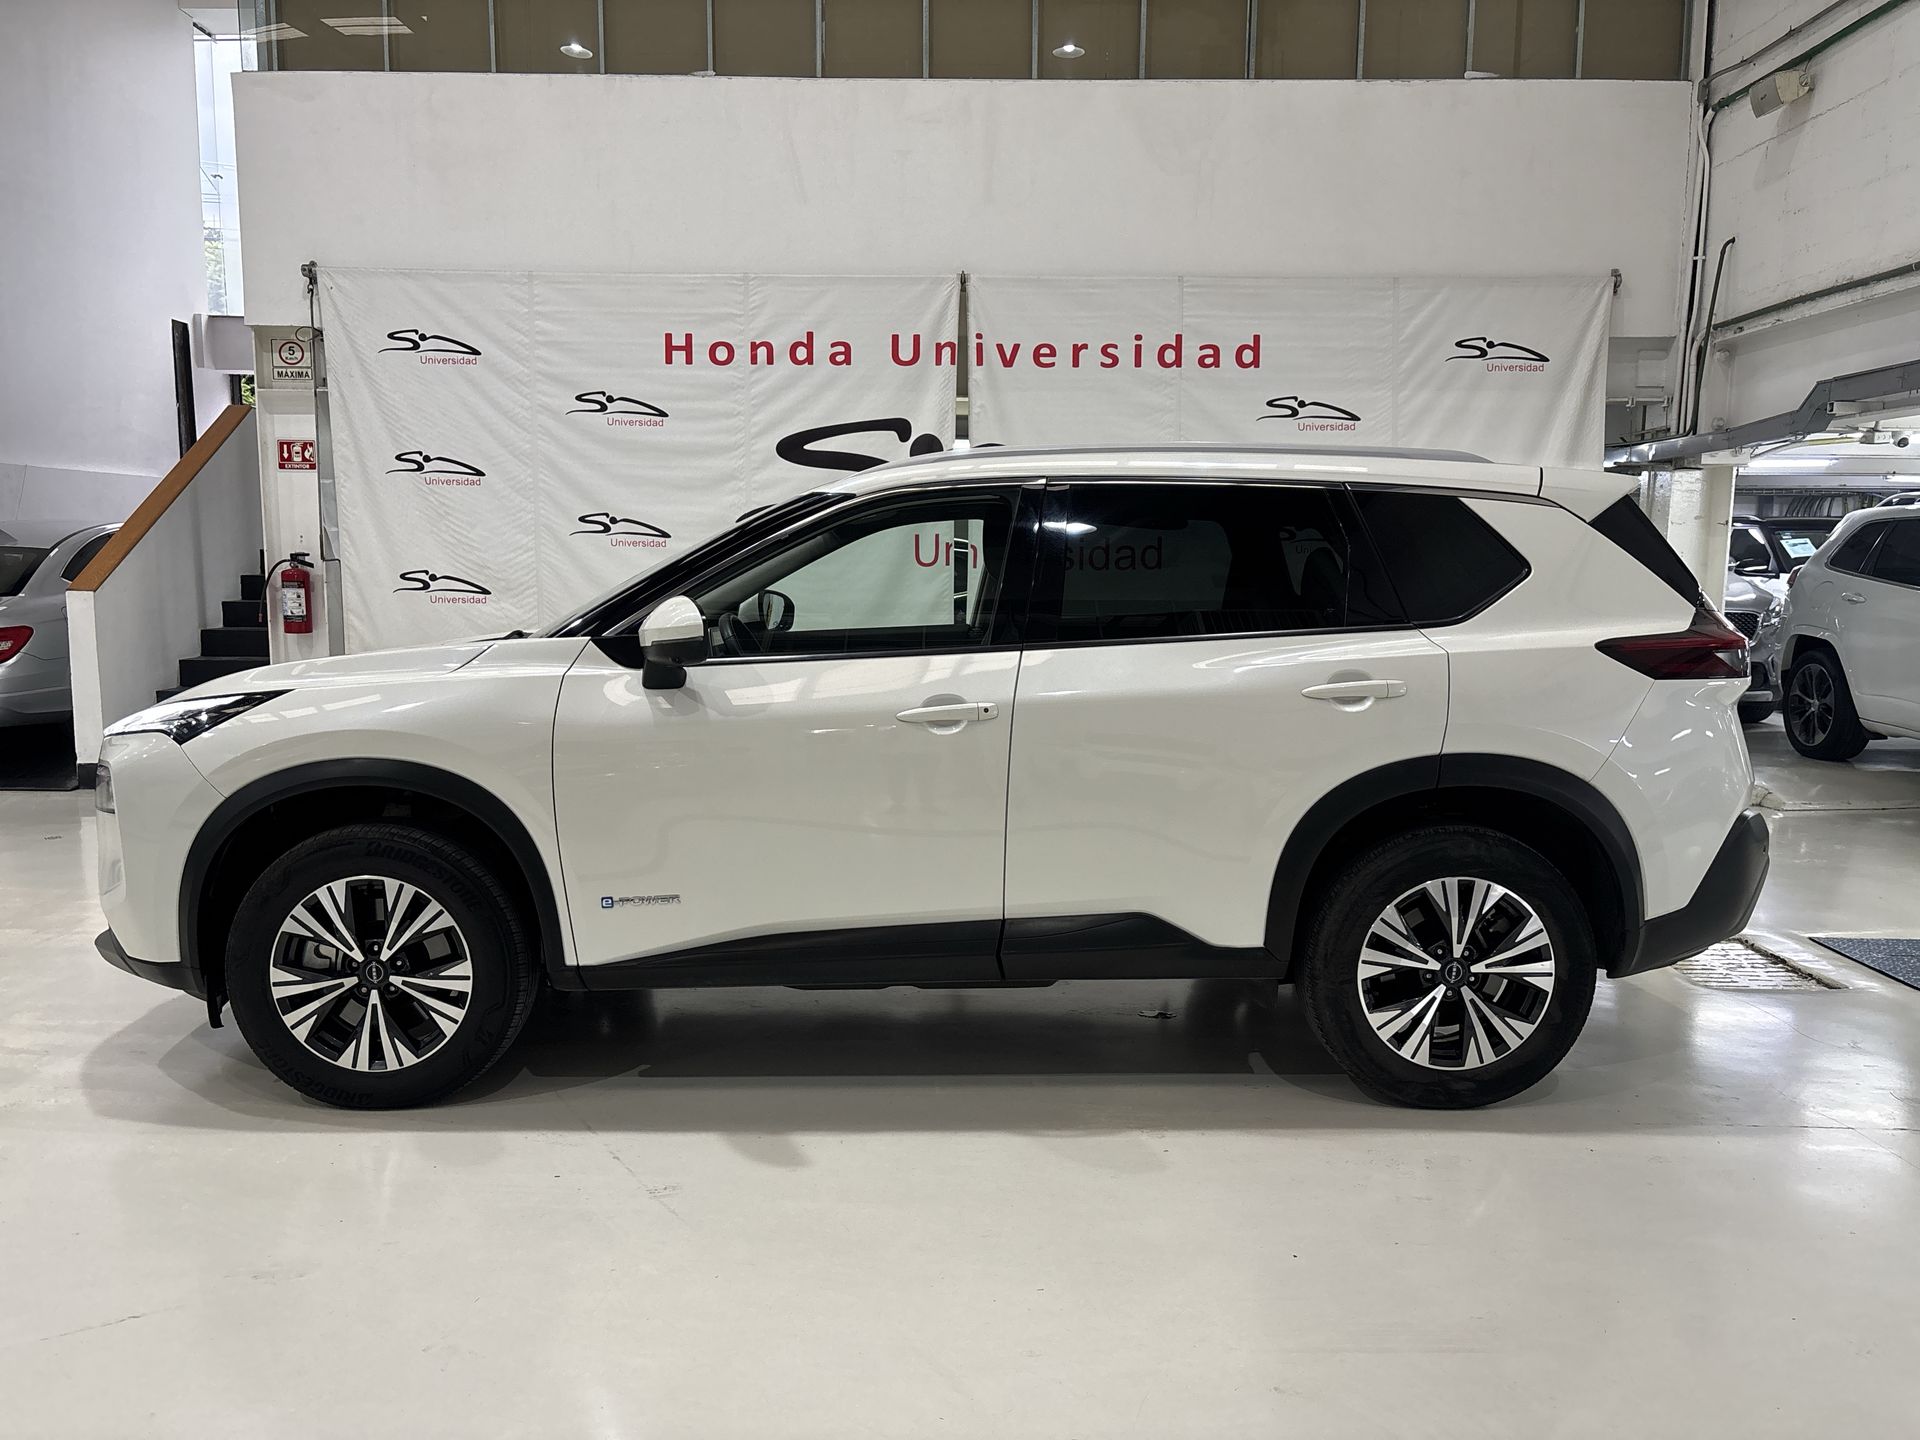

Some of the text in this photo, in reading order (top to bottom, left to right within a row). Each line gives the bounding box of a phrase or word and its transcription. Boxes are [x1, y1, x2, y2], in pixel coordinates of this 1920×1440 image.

[288, 346, 295, 356] 5
[663, 331, 1261, 369] Honda Universidad
[419, 355, 478, 366] Universidad
[1486, 363, 1545, 372] Universidad
[606, 417, 664, 427] Universidad
[1297, 422, 1356, 431] Universidad
[424, 476, 482, 486] Universidad
[610, 538, 667, 548] Universidad
[430, 594, 487, 604] Universidad
